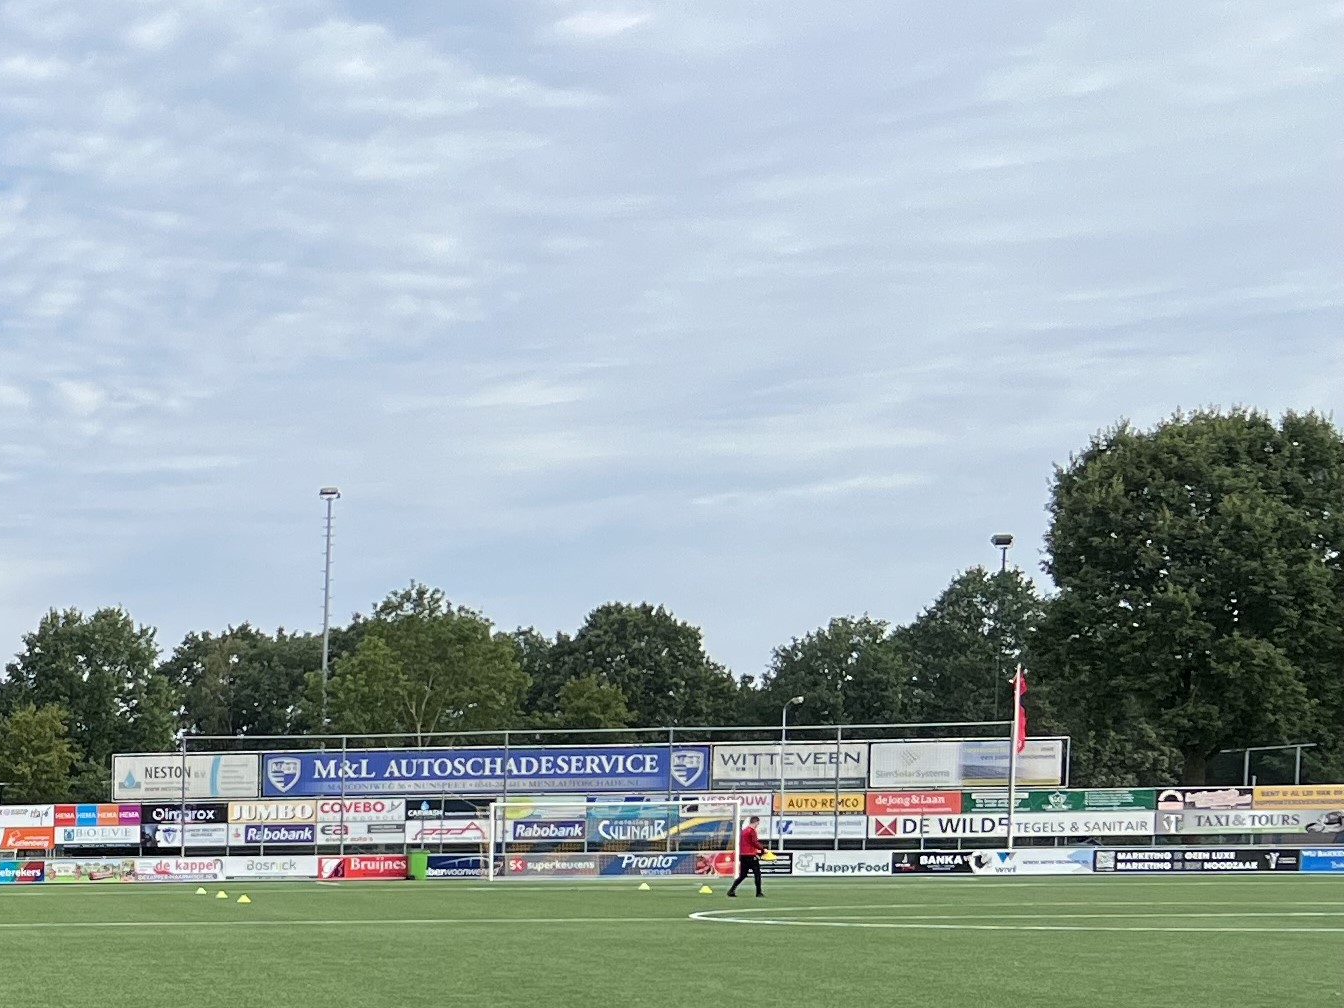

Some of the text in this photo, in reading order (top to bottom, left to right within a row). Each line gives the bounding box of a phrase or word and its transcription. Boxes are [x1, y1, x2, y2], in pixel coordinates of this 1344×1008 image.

[721, 751, 861, 766] WITTEVEEN
[144, 766, 191, 779] NESTON
[313, 754, 659, 779] M&L AUTOSCHADESERVICE
[320, 802, 385, 813] COVEBO
[787, 797, 859, 809] AUTO-REMCO
[98, 811, 118, 819] HEMA
[119, 811, 139, 819] HEMA
[231, 804, 313, 821] JUMBO
[902, 818, 930, 834] DE
[1016, 820, 1148, 833] TEGELS & SANITAIR
[1195, 814, 1300, 827] TAXI & TOURS
[247, 827, 312, 842] Rabobank
[515, 824, 583, 838] Rabobank
[618, 854, 678, 869] Pronto
[1117, 852, 1172, 860] MARKETING
[1212, 851, 1236, 860] LUXE
[155, 860, 218, 873] de kapper
[350, 857, 406, 873] Bruijnes
[815, 862, 889, 874] HappyFood
[1117, 862, 1172, 870] MARKETING
[1203, 861, 1258, 870] NOODZAAK
